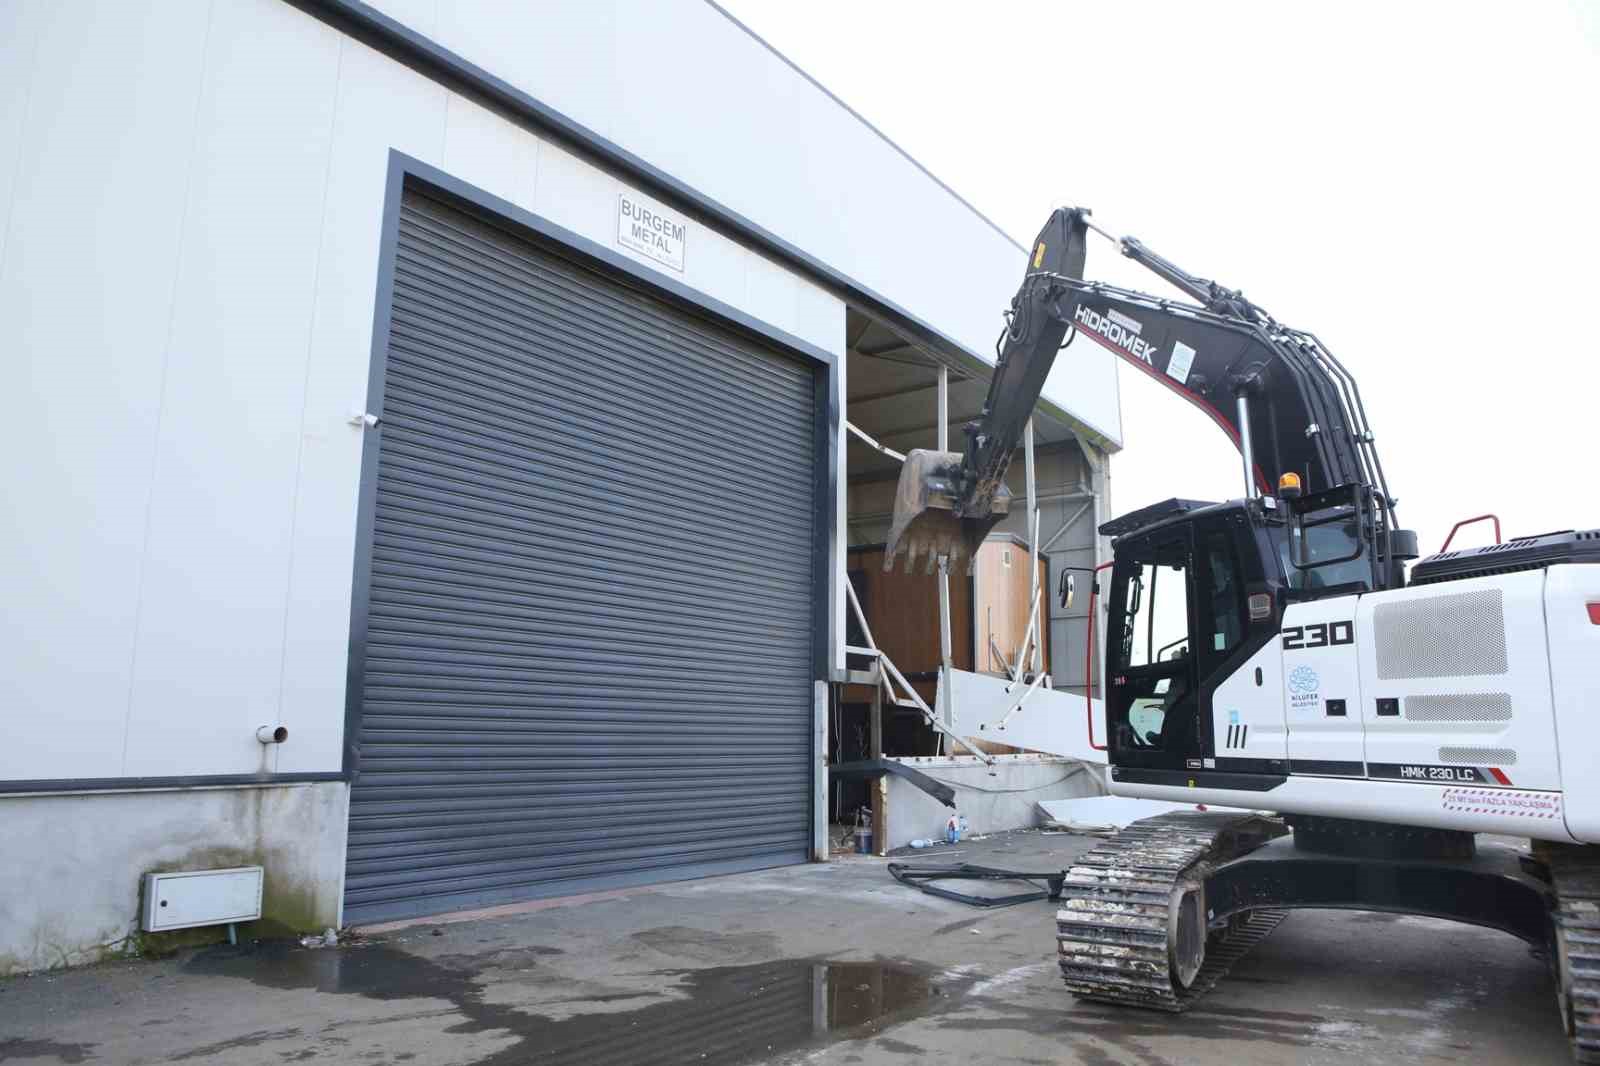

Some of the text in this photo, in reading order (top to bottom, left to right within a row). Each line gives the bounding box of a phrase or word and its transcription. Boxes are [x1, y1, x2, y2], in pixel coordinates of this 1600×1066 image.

[621, 199, 683, 242] BURGEM
[631, 223, 672, 254] METAL
[1282, 620, 1354, 650] 230
[1400, 766, 1475, 781] HMK 230 LC
